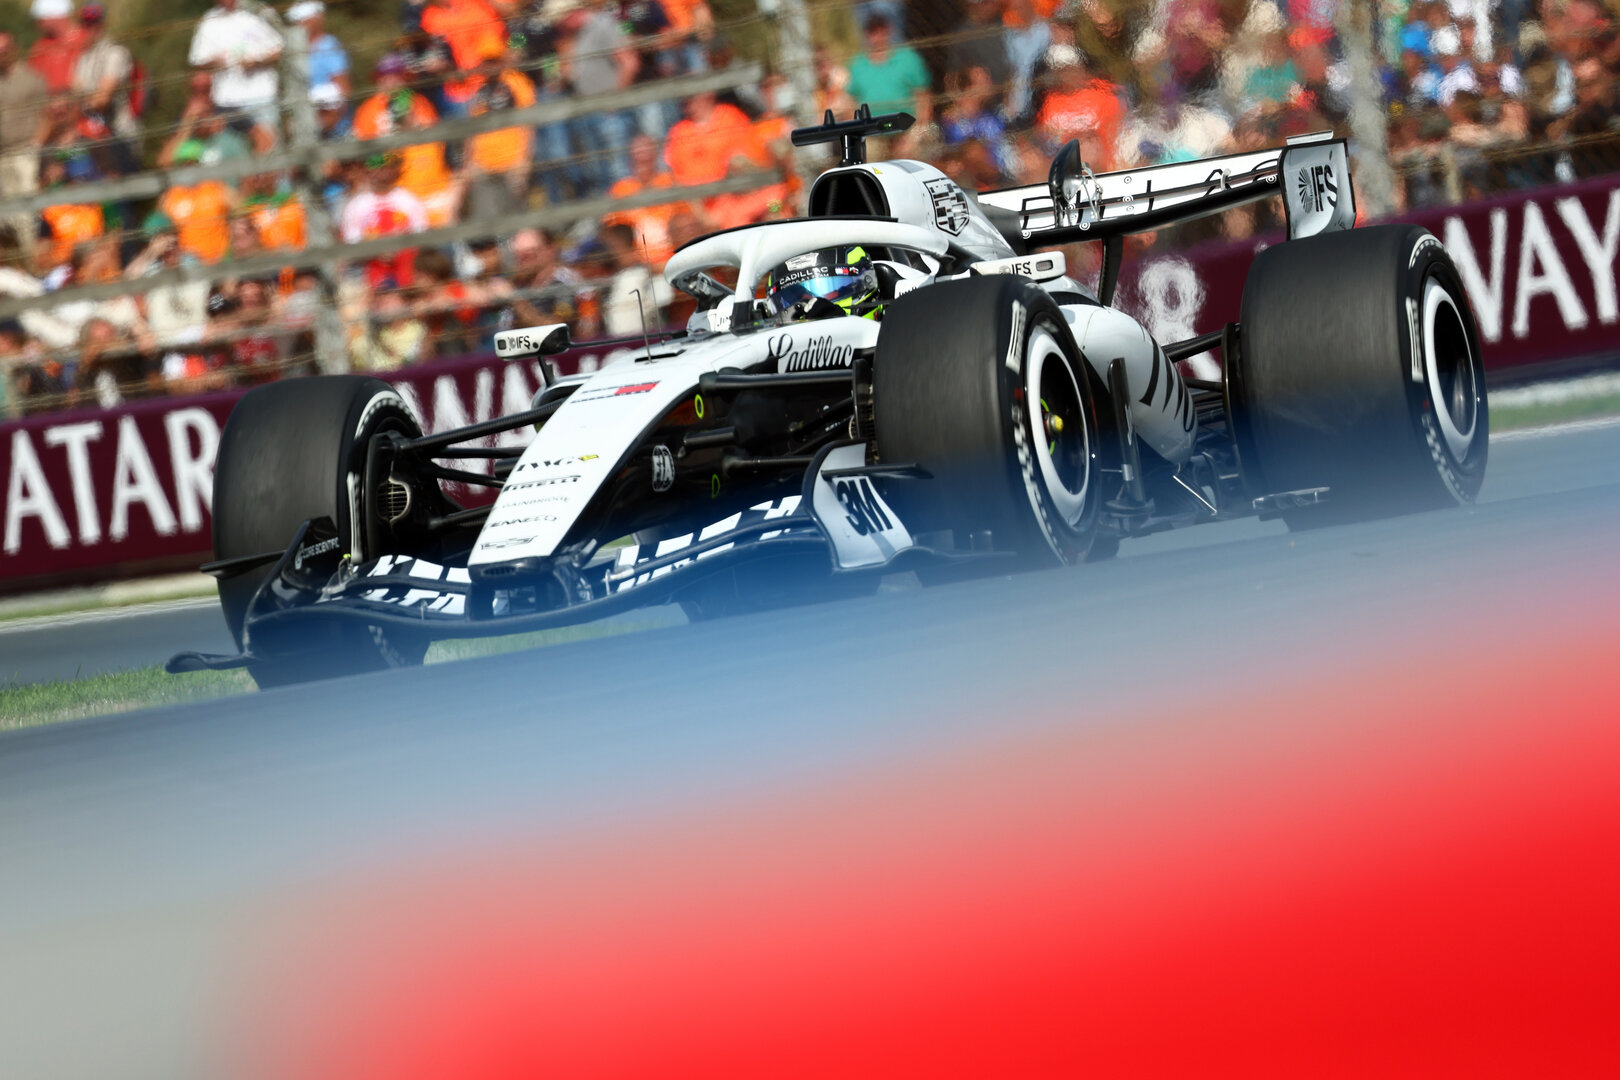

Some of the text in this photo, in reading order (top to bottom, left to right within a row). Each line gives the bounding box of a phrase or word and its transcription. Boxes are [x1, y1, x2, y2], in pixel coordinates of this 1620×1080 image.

[1311, 164, 1338, 212] IFS
[780, 266, 829, 285] CADILLAC
[1011, 261, 1032, 275] IFS
[516, 336, 531, 350] IFS
[768, 333, 854, 374] Cadillac
[836, 477, 894, 536] 3M
